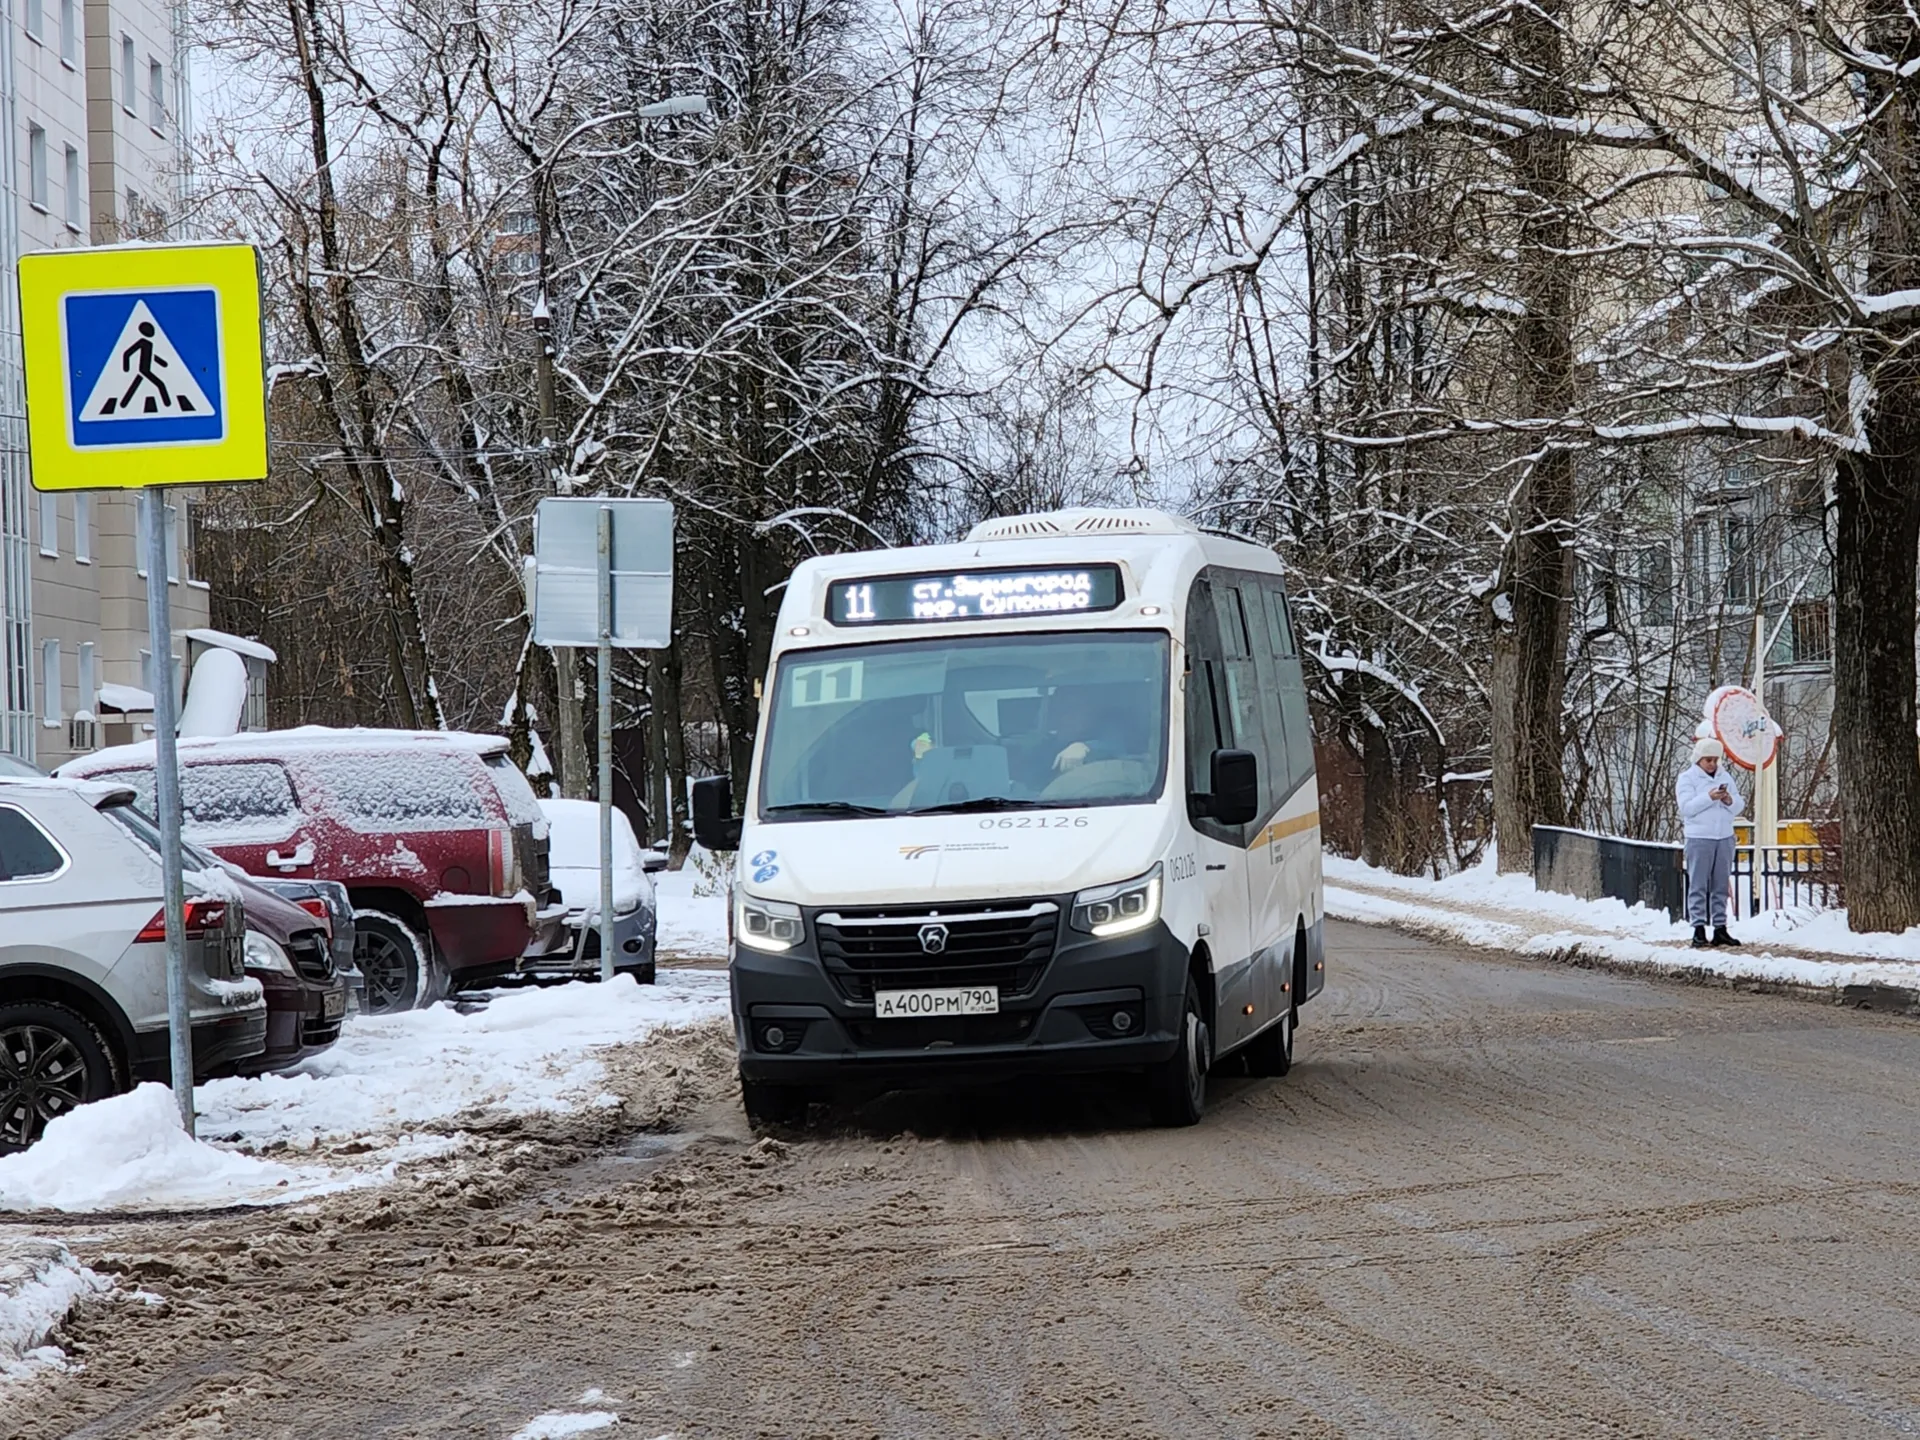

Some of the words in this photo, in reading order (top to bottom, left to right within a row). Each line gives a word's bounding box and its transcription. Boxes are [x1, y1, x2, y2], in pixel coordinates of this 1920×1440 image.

[845, 584, 875, 619] 11
[796, 666, 852, 702] 11
[979, 816, 1088, 829] 062126
[961, 990, 992, 1006] 790
